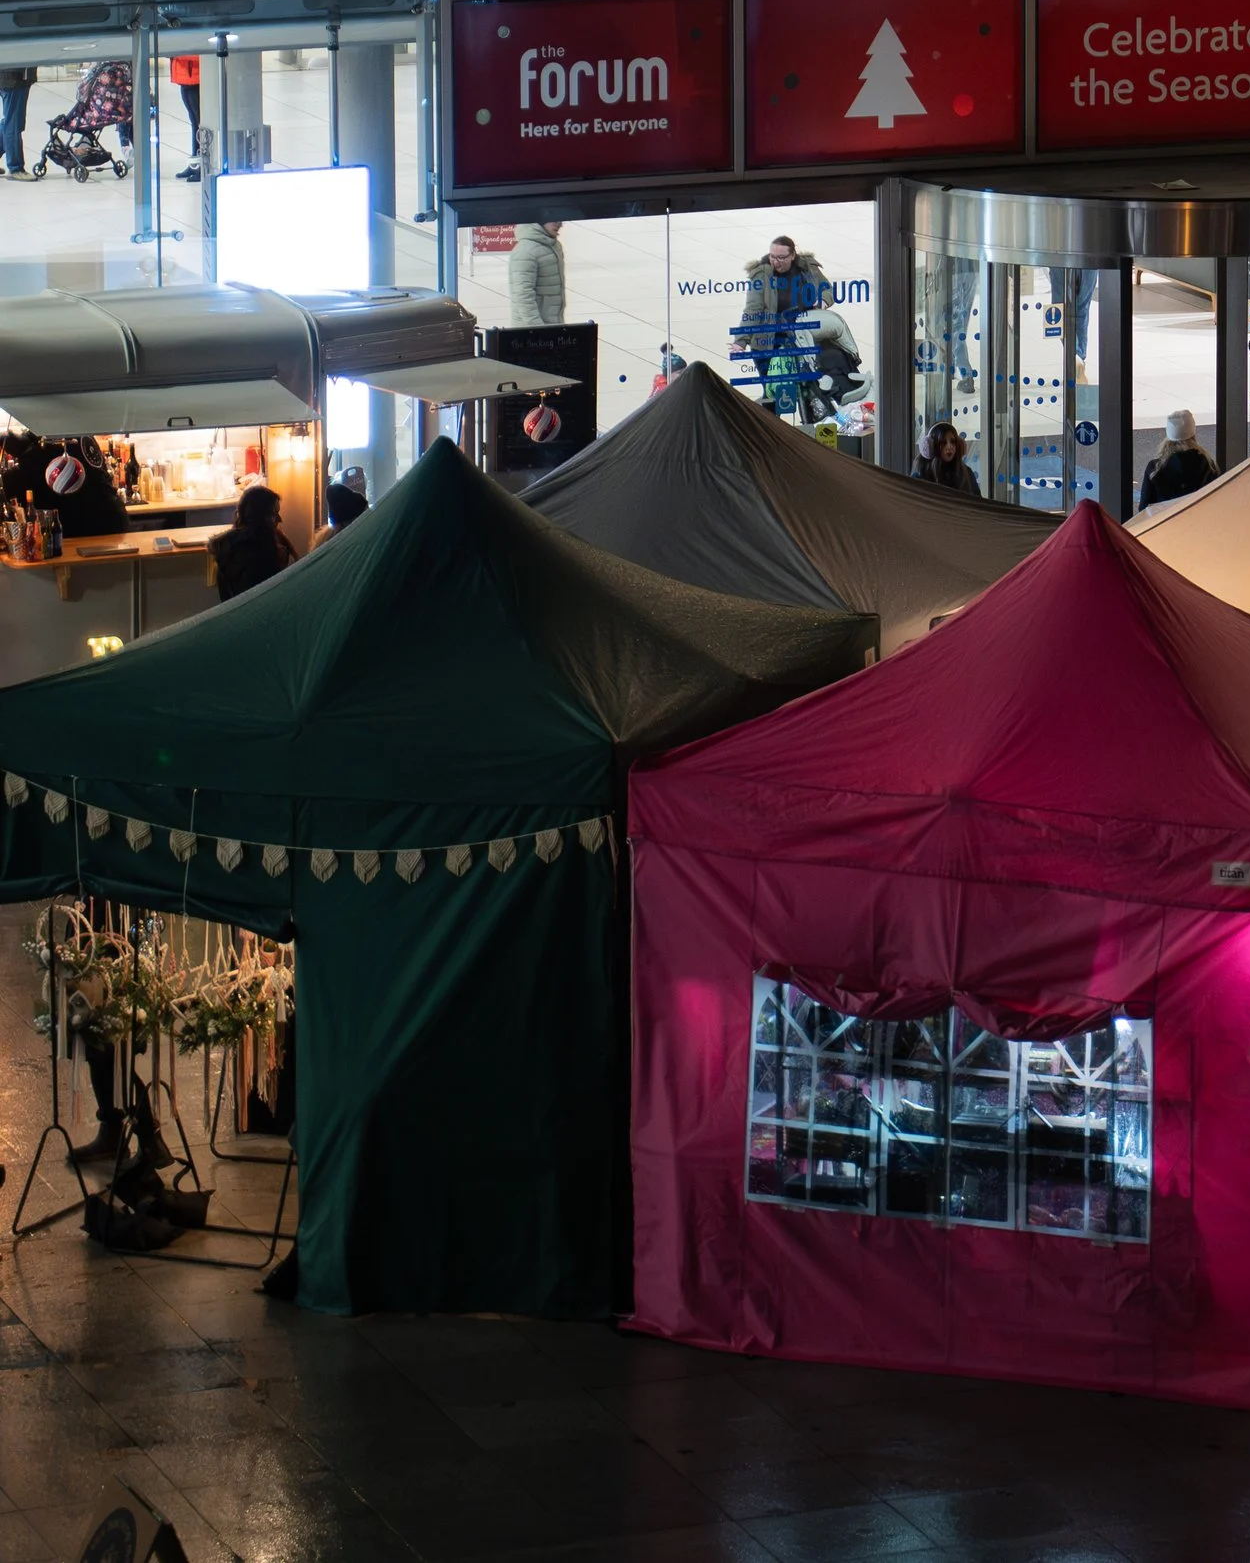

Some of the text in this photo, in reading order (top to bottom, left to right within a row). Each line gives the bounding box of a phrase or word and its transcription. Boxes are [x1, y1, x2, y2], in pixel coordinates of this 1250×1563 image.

[541, 46, 565, 58] the
[520, 49, 668, 109] forum
[1070, 68, 1135, 107] the
[520, 116, 669, 138] Here for Everyone
[678, 275, 869, 308] Welcome to forum
[1219, 868, 1245, 879] titan
